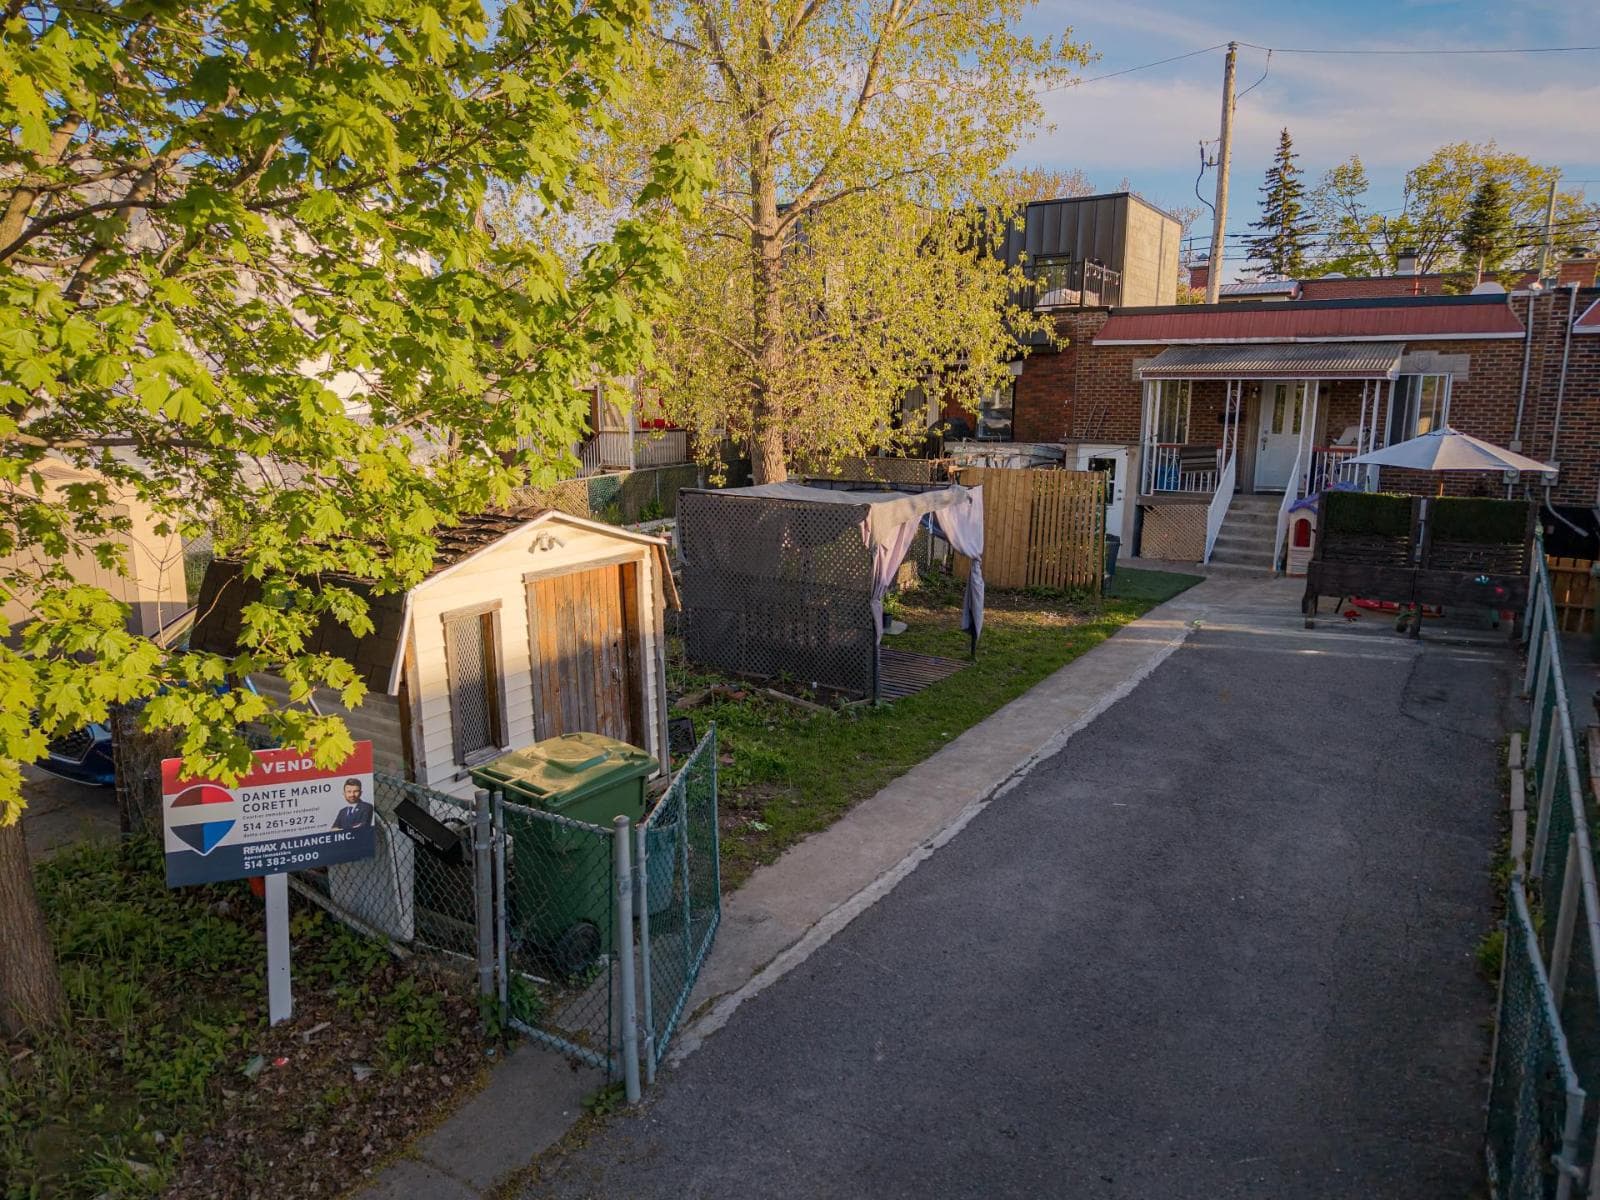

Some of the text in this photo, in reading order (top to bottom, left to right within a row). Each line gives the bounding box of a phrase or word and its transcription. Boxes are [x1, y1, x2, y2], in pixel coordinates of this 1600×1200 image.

[261, 758, 315, 774] VEND
[242, 784, 332, 803] DANTE MARIO
[242, 798, 299, 813] CORETTI
[243, 822, 261, 832] 514
[266, 815, 316, 829] 261-9272
[280, 834, 332, 850] ALLIANCE
[334, 832, 356, 842] INC.
[244, 851, 320, 870] 514 382-5000
